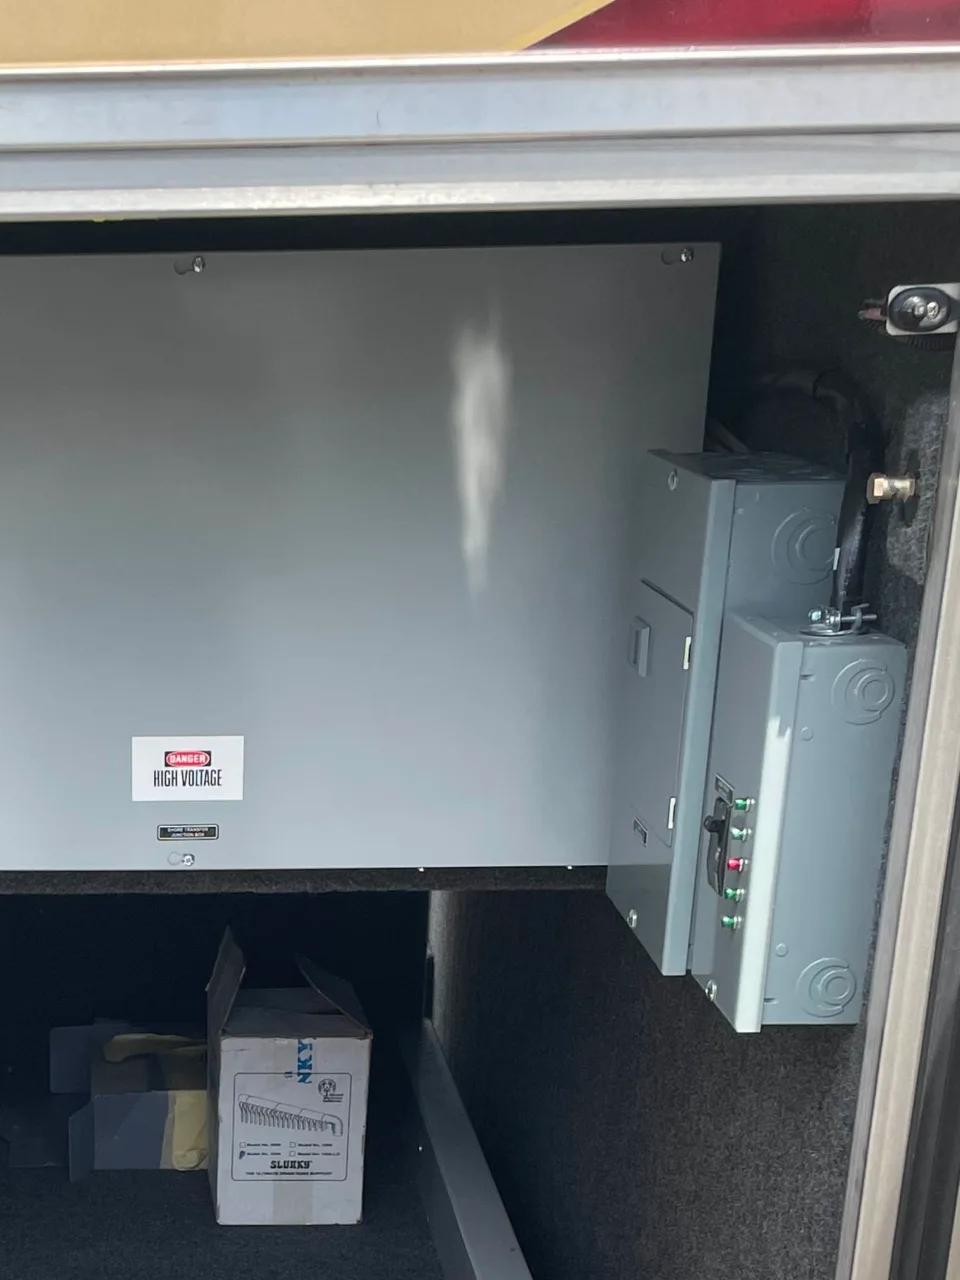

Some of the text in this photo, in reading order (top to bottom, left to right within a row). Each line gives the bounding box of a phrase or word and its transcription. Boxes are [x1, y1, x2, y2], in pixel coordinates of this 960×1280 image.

[169, 754, 206, 764] DANGER
[153, 769, 222, 787] HIGH VOLTAGE
